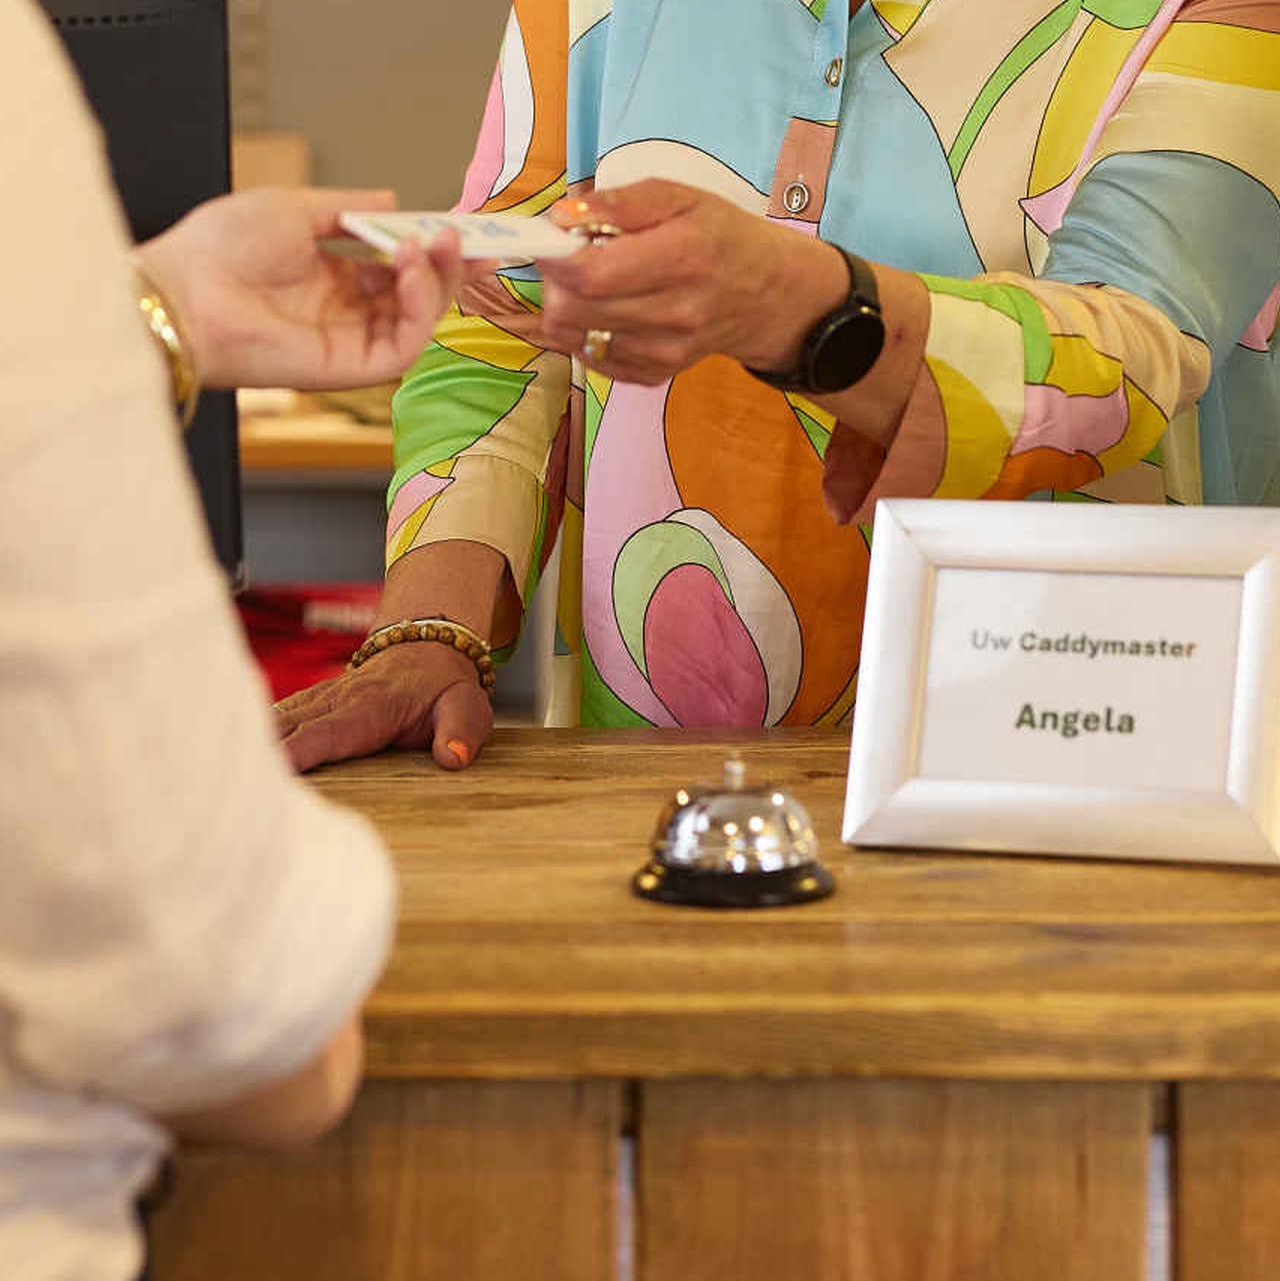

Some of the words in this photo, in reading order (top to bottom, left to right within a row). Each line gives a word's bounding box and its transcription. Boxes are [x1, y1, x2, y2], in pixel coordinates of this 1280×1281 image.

[971, 630, 1011, 650] Uw
[1019, 631, 1197, 658] Caddymaster
[1014, 703, 1136, 737] Angela
